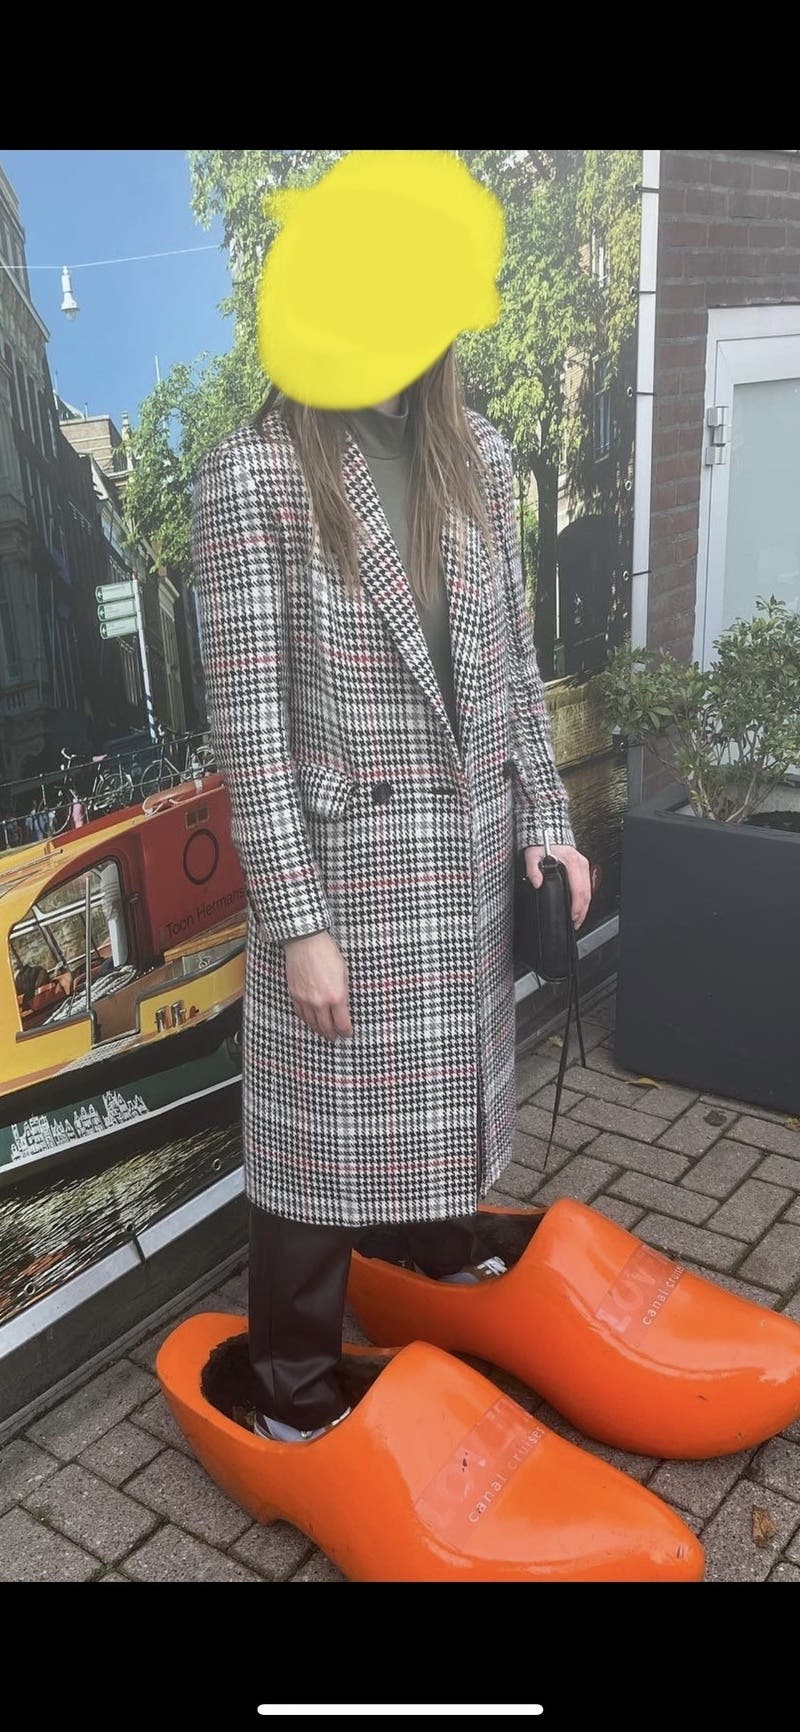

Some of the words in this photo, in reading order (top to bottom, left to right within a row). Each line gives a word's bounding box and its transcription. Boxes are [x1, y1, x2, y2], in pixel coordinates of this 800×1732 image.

[166, 914, 195, 938] Toon
[642, 1289, 669, 1325] canal
[468, 1474, 507, 1523] canal
